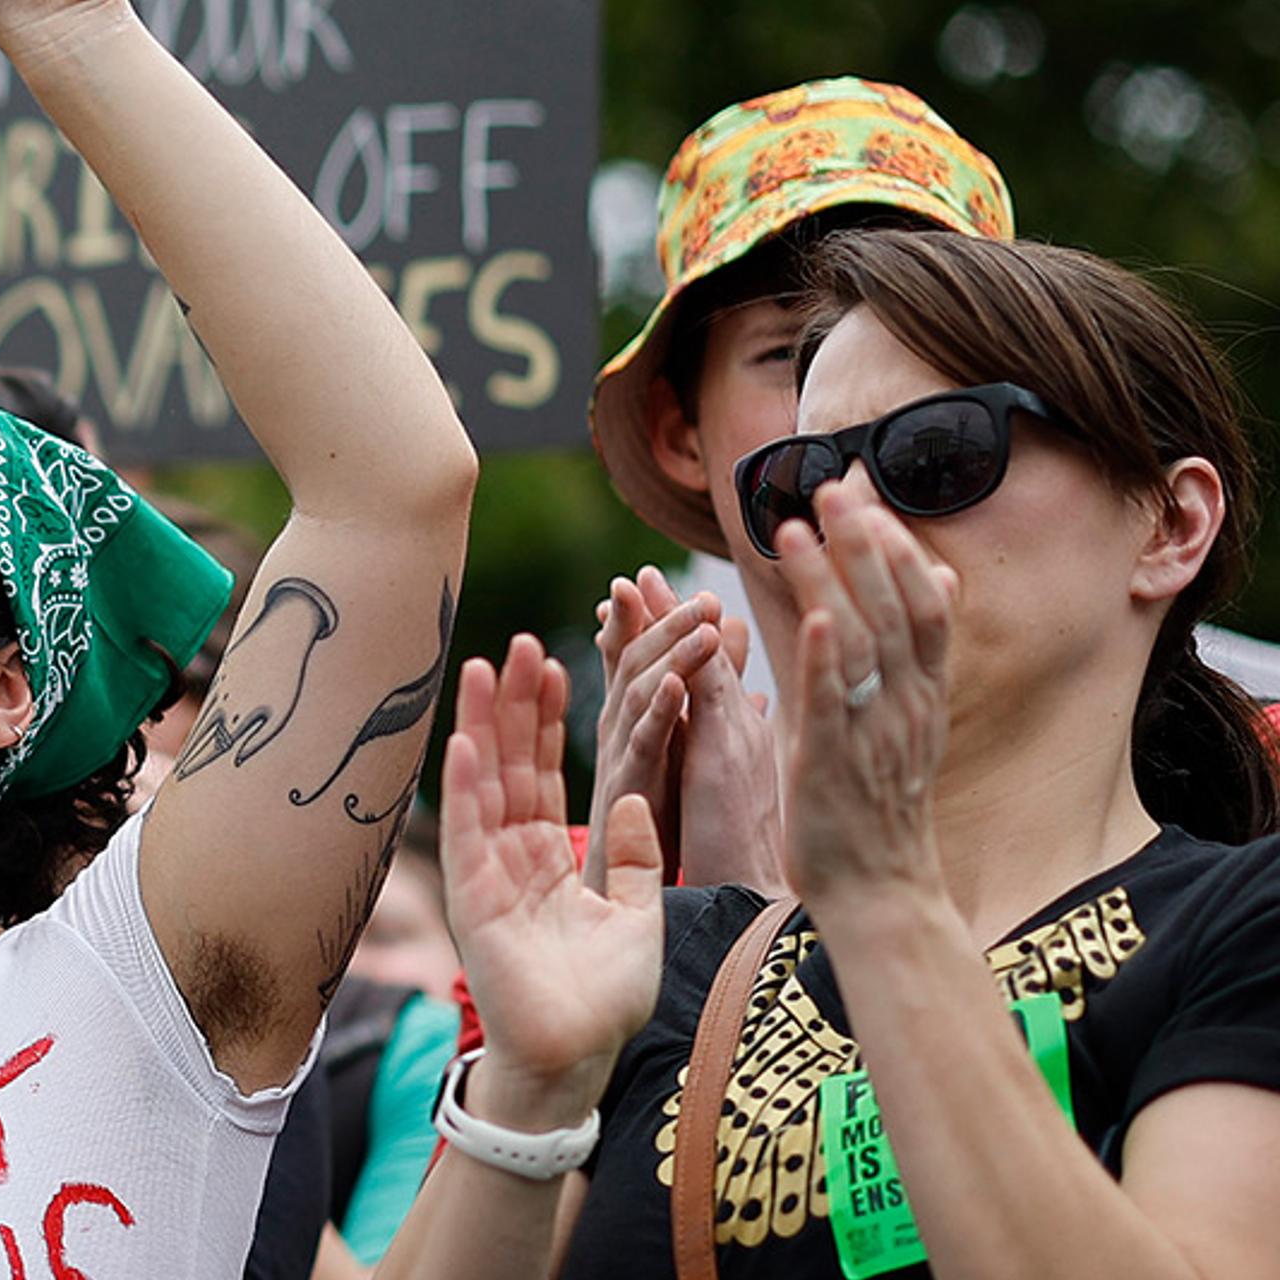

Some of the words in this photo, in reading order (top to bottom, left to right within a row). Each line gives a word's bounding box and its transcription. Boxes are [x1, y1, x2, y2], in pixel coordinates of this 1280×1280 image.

[316, 98, 546, 253] OFF
[847, 1144, 883, 1185] IS
[850, 1177, 904, 1218] ENS
